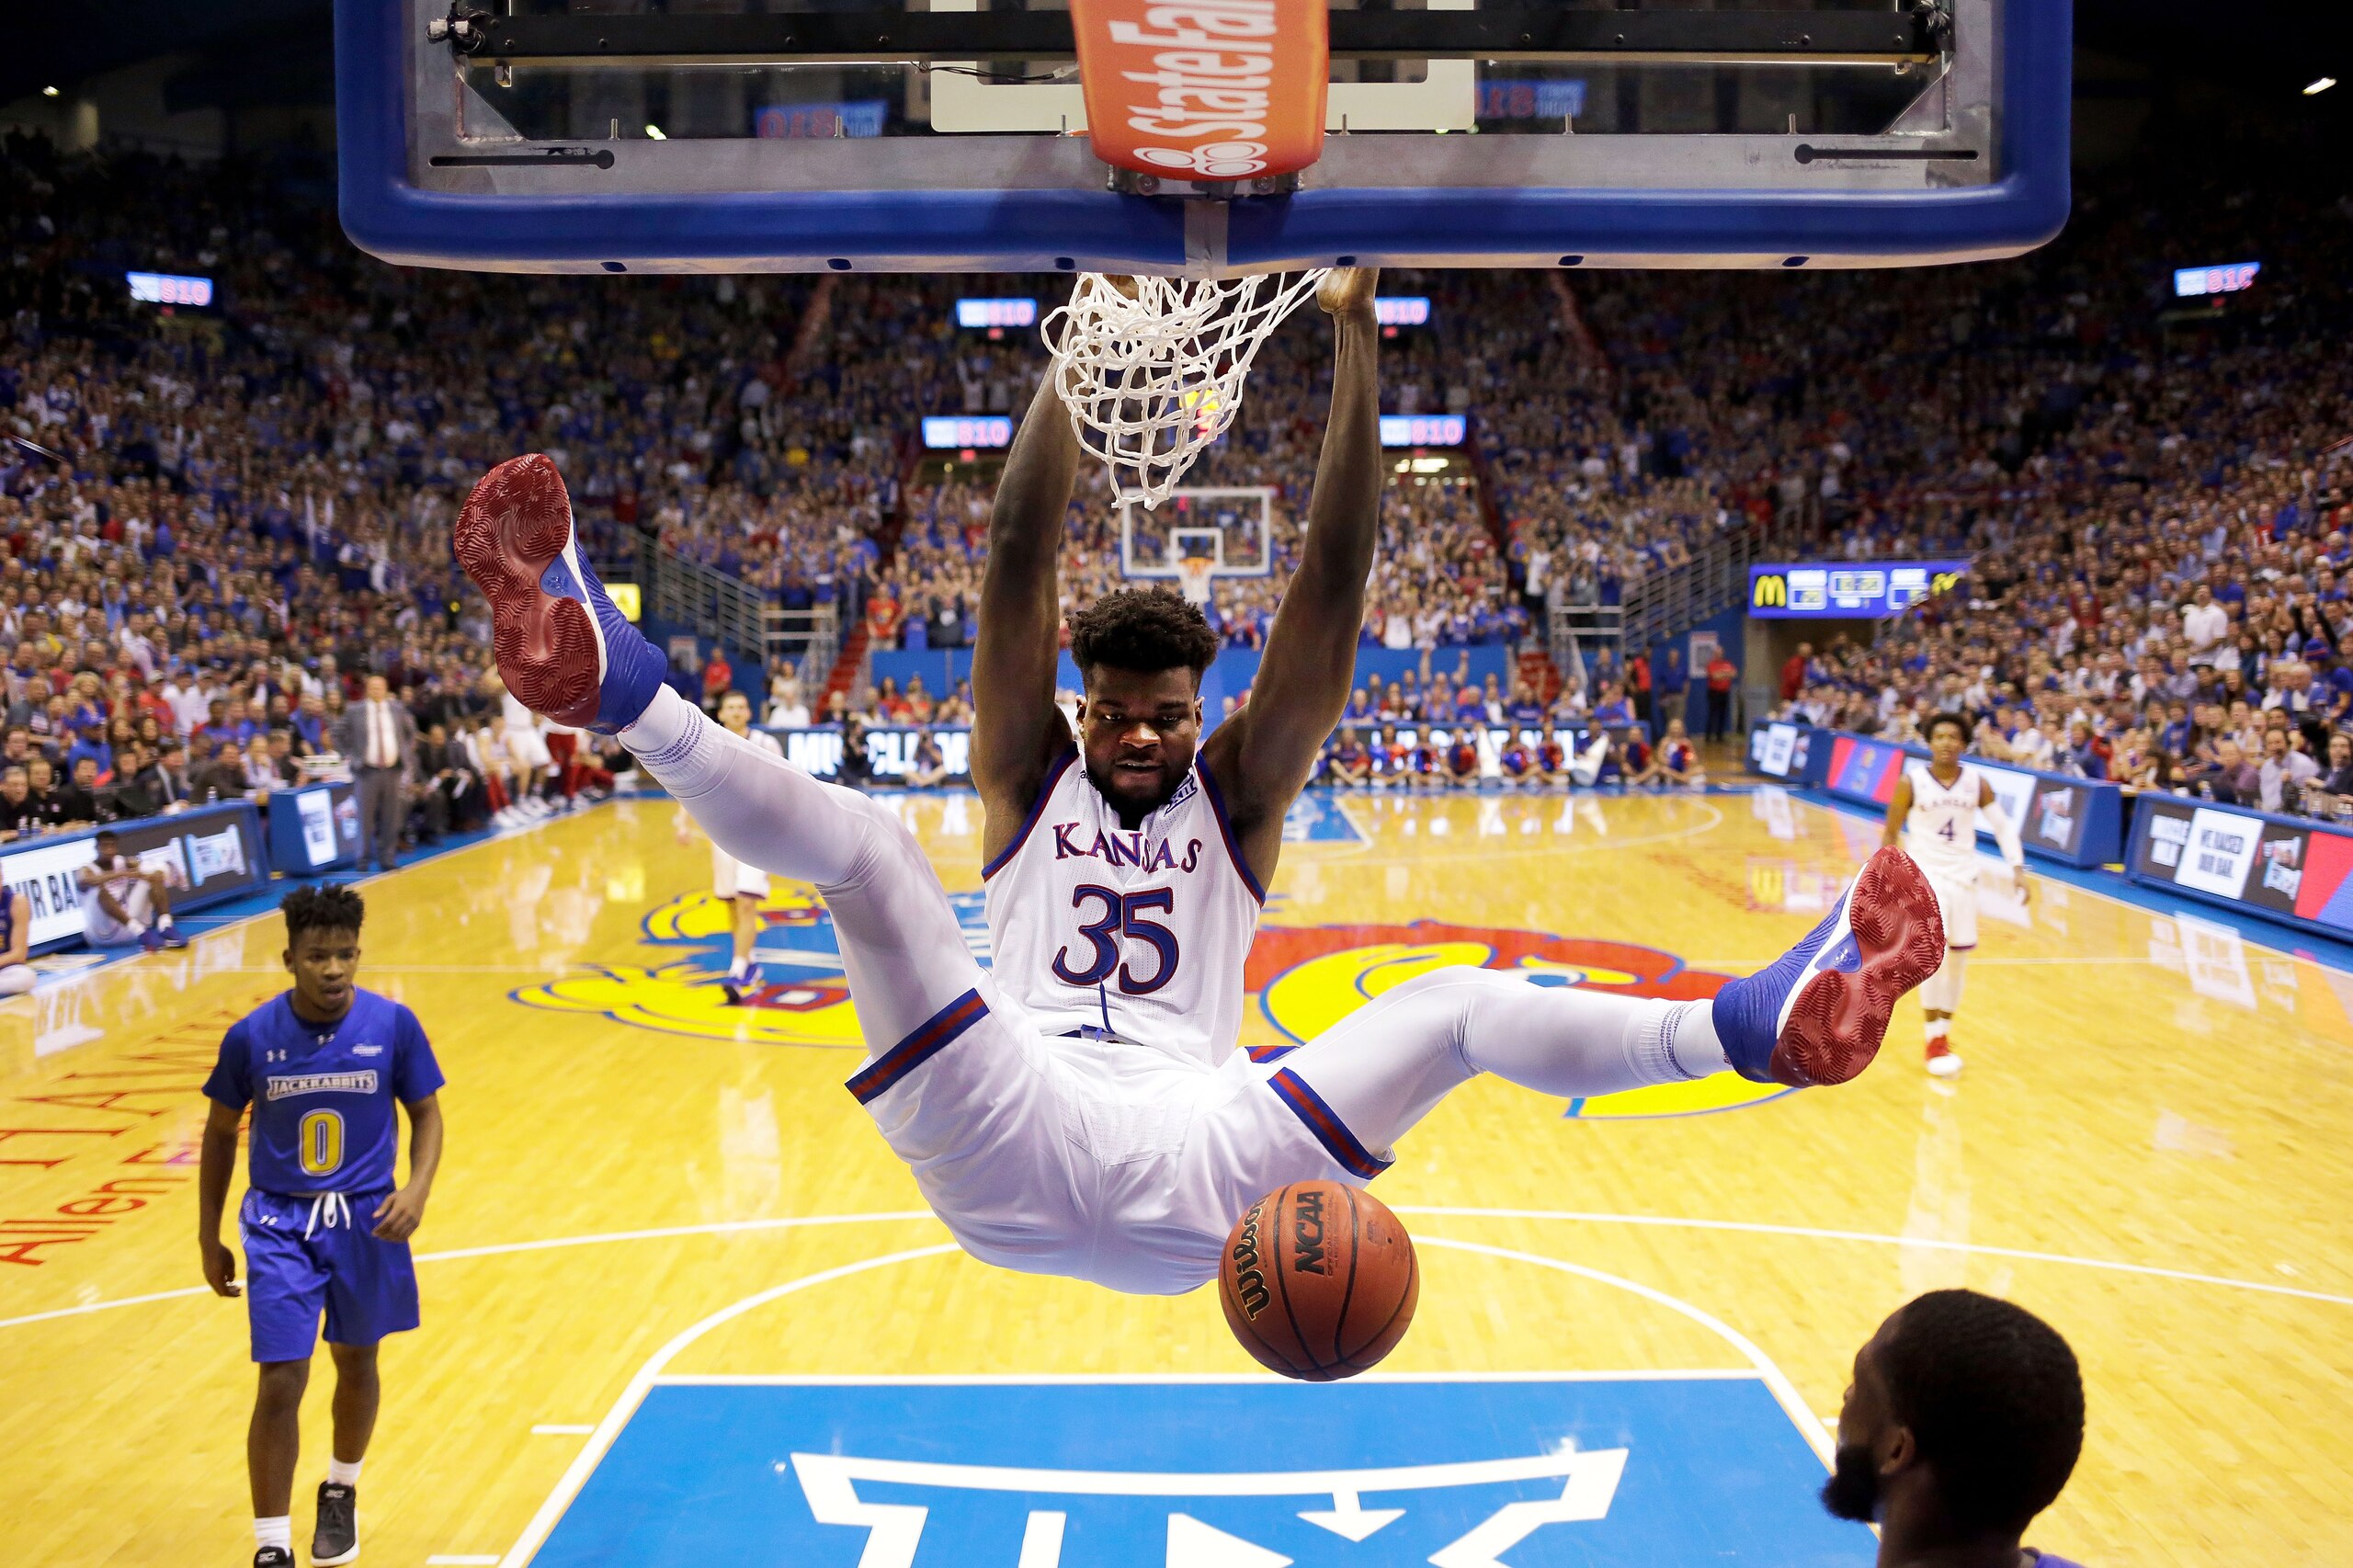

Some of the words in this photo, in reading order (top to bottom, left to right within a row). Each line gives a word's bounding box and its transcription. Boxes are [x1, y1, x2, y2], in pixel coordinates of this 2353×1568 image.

[1052, 823, 1202, 873] KANSAS
[1938, 816, 1955, 841] 4
[1052, 883, 1179, 994] 35
[269, 1074, 374, 1097] JACKRABBITS
[299, 1108, 345, 1176] 0
[1294, 1191, 1324, 1276] NCAA
